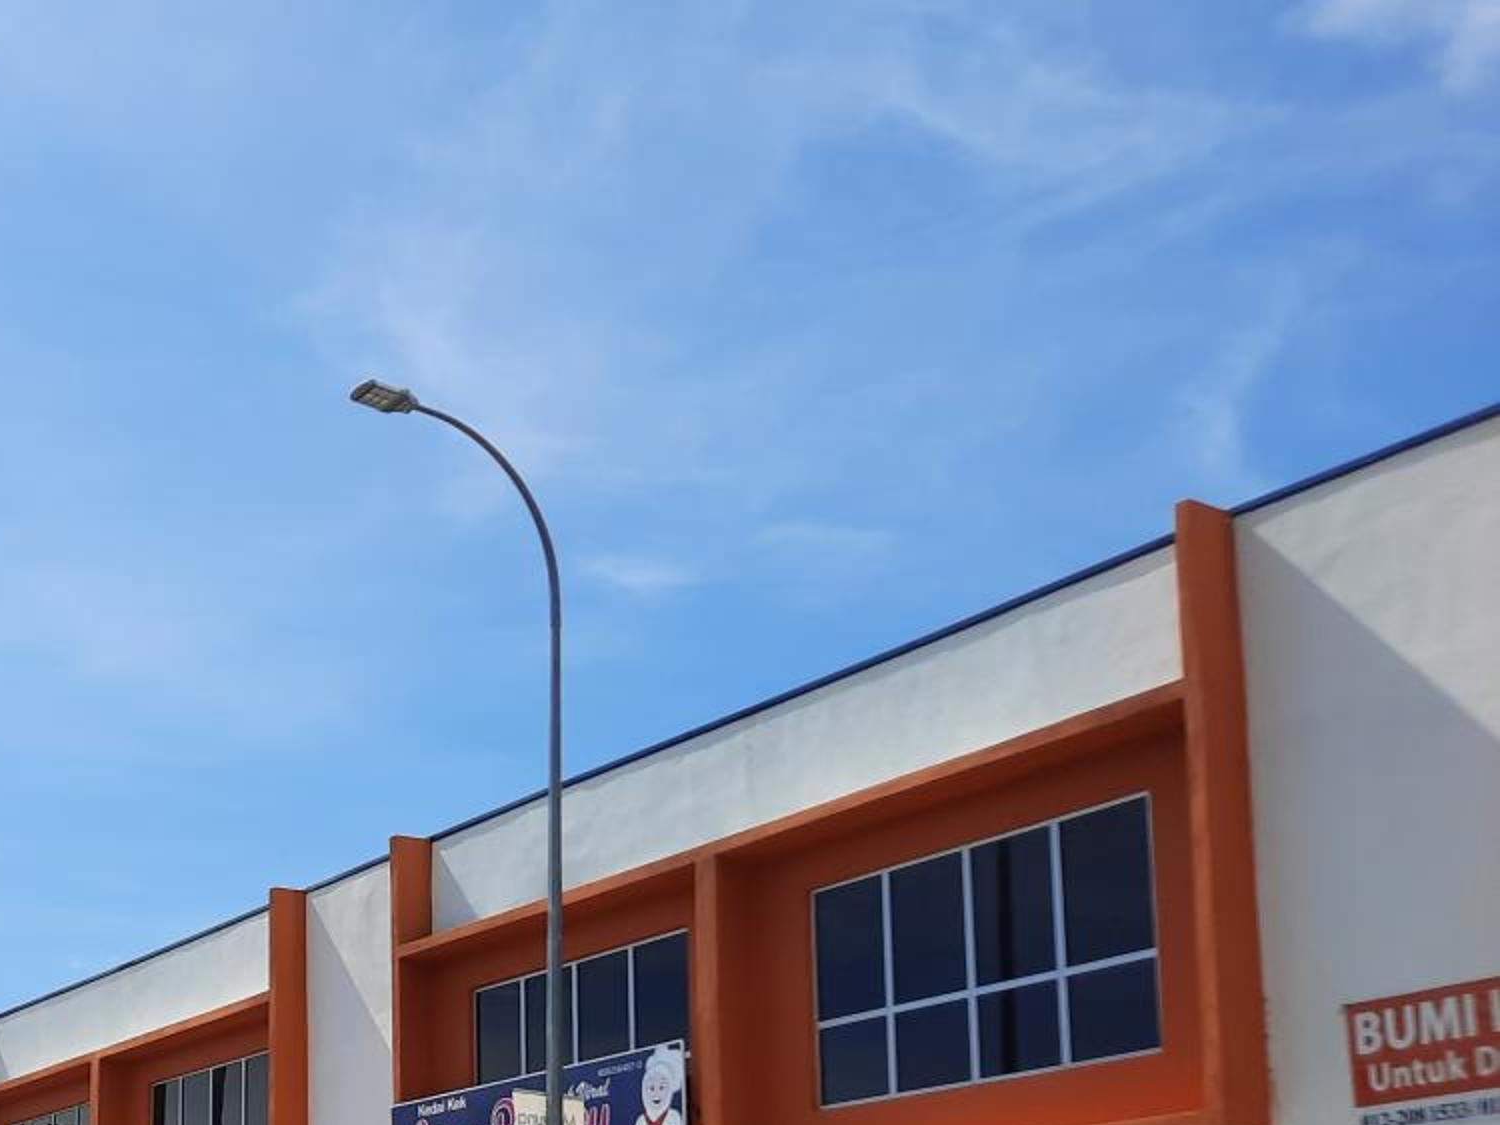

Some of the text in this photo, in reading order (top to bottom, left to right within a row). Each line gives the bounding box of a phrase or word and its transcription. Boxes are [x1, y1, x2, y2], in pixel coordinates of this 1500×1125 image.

[1355, 992, 1476, 1055] BUMI
[1368, 1053, 1468, 1091] Untuk
[418, 1099, 445, 1117] Kedai
